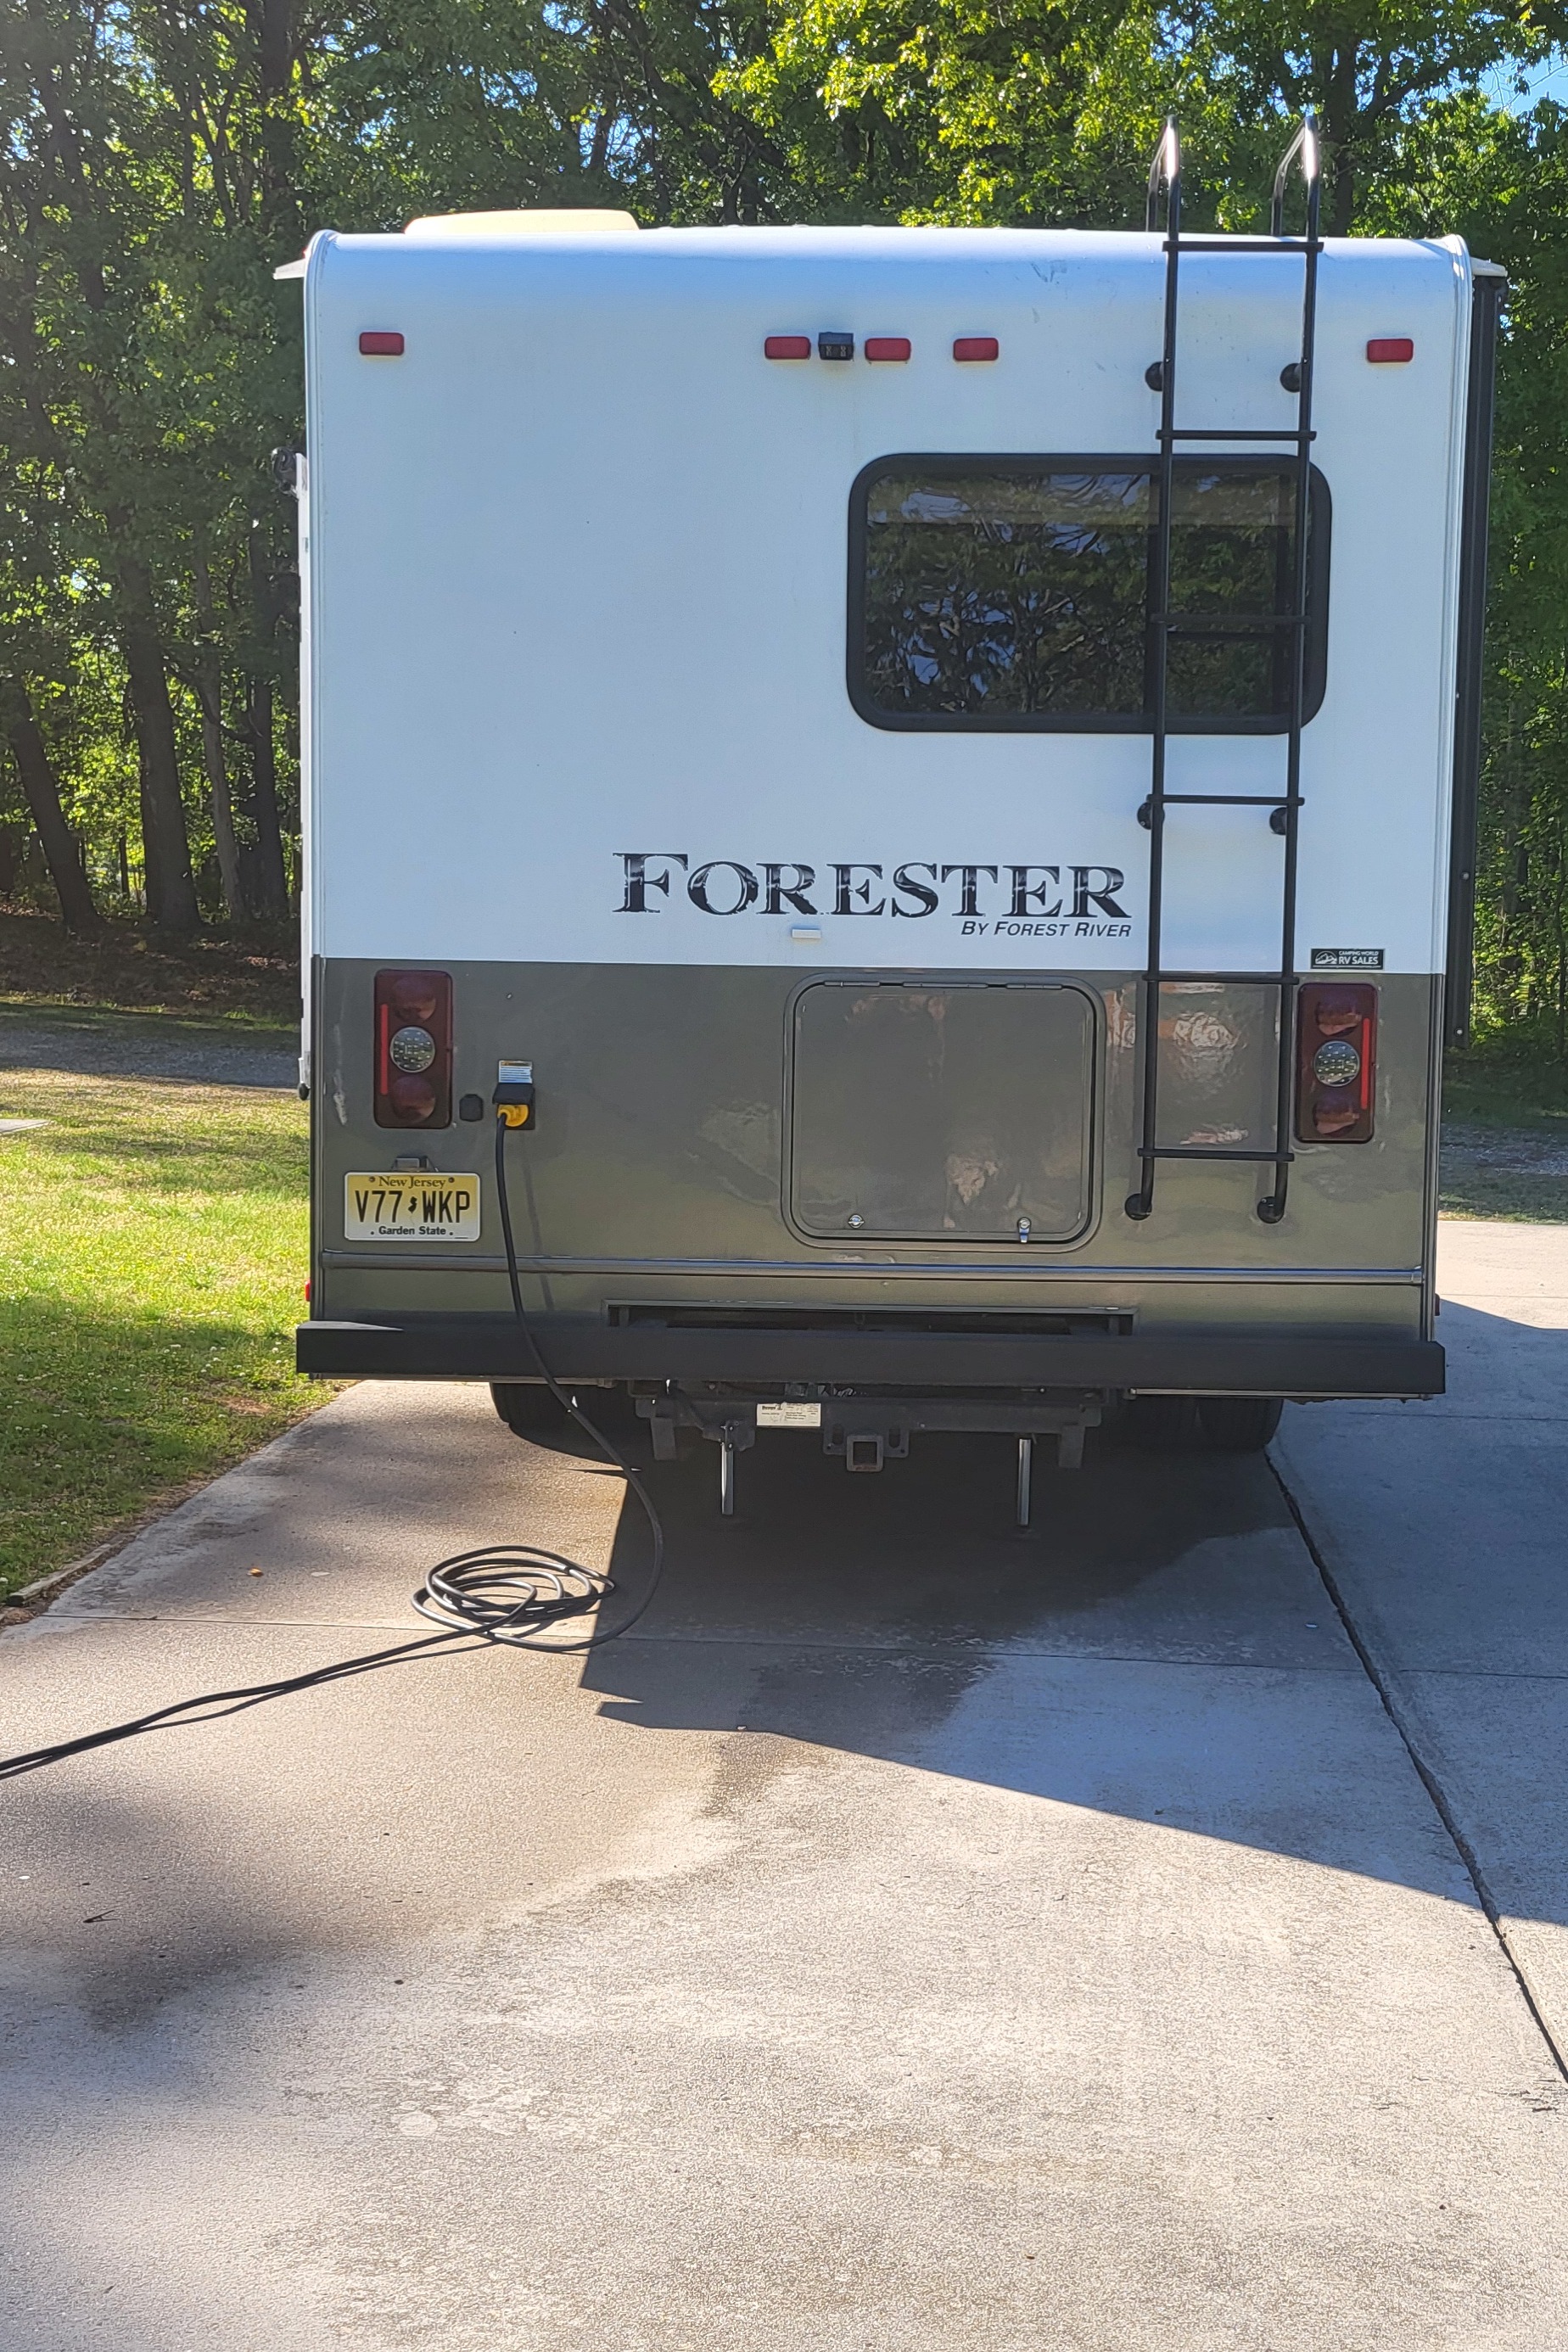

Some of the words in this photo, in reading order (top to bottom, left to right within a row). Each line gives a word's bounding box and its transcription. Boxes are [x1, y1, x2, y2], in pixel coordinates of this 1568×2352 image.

[612, 852, 1132, 918] FORESTER
[994, 921, 1070, 937] FOREST
[1074, 922, 1132, 938] RIVER
[1352, 956, 1379, 965] SALES
[378, 1176, 407, 1186] New
[408, 1176, 446, 1189] Jersey
[355, 1190, 403, 1223] V77
[422, 1190, 470, 1223] WKP
[378, 1226, 415, 1235] Garden
[418, 1226, 446, 1235] State
